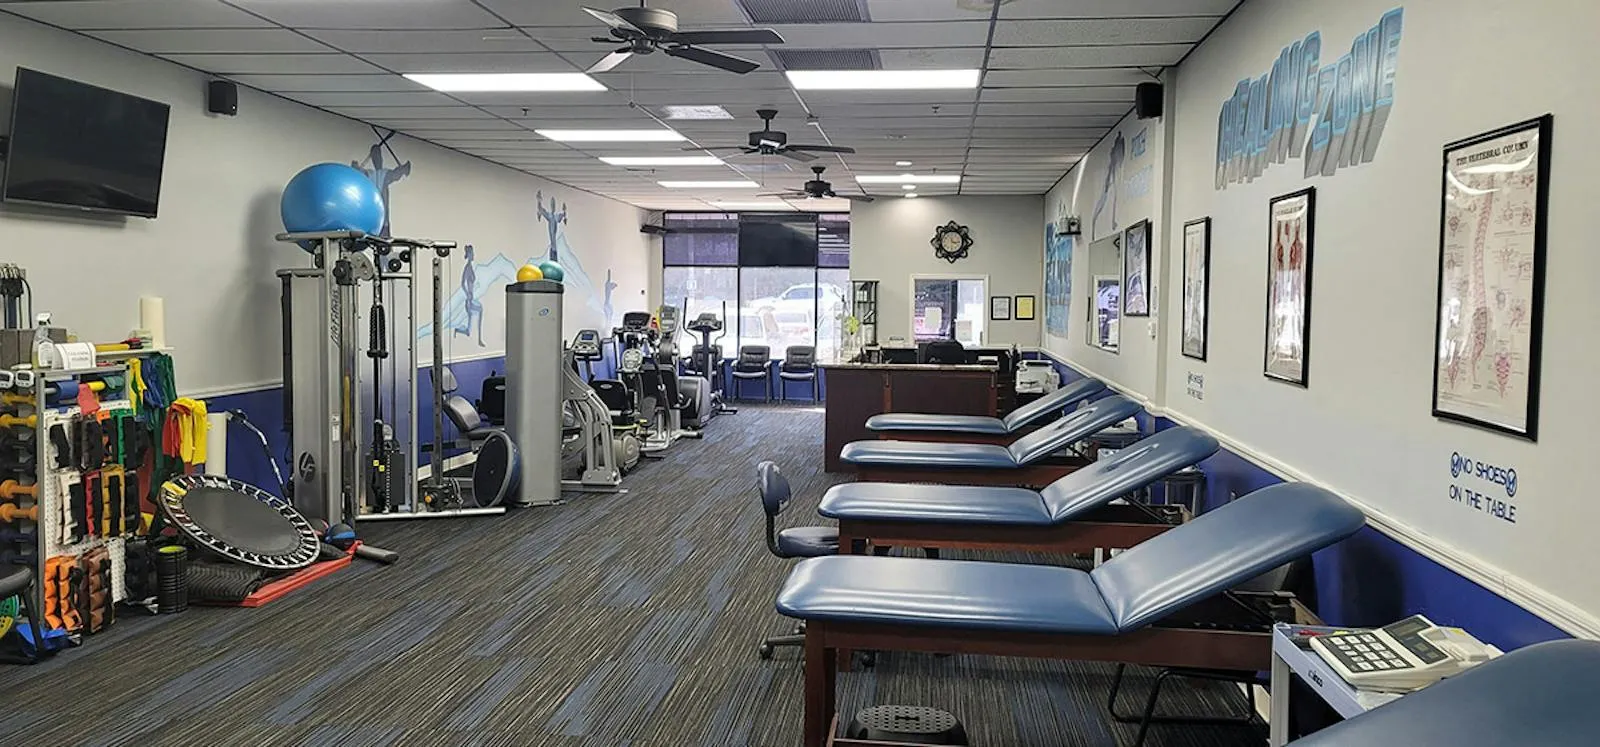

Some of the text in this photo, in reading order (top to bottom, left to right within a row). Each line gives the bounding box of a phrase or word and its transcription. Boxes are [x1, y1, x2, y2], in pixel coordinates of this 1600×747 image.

[1216, 7, 1404, 176] HEALING ZONE
[1460, 456, 1506, 486] NO SHOES
[1449, 484, 1517, 524] ON THE TABLE
